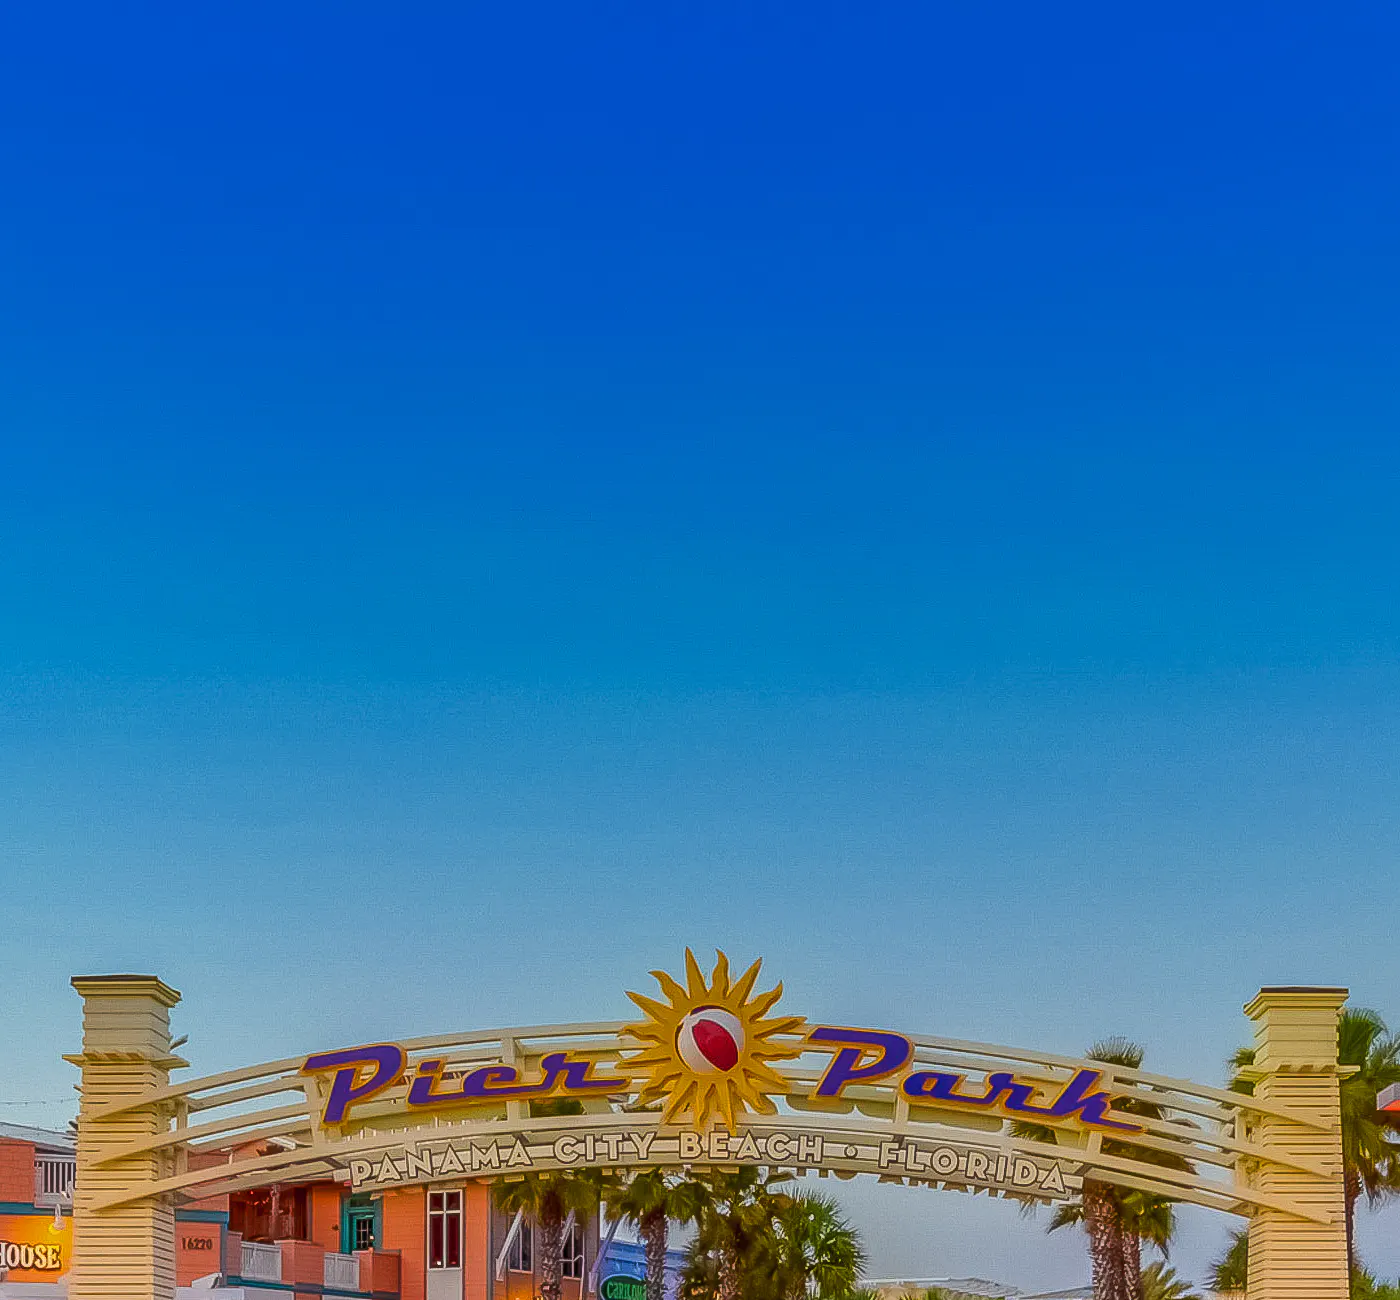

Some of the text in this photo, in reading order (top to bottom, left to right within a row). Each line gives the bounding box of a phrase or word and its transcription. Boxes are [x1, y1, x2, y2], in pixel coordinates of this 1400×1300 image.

[301, 1026, 1148, 1135] Pier Park
[350, 1131, 1070, 1193] PANAMA CITY BEACH FLORIDA
[181, 1236, 213, 1250] 16220
